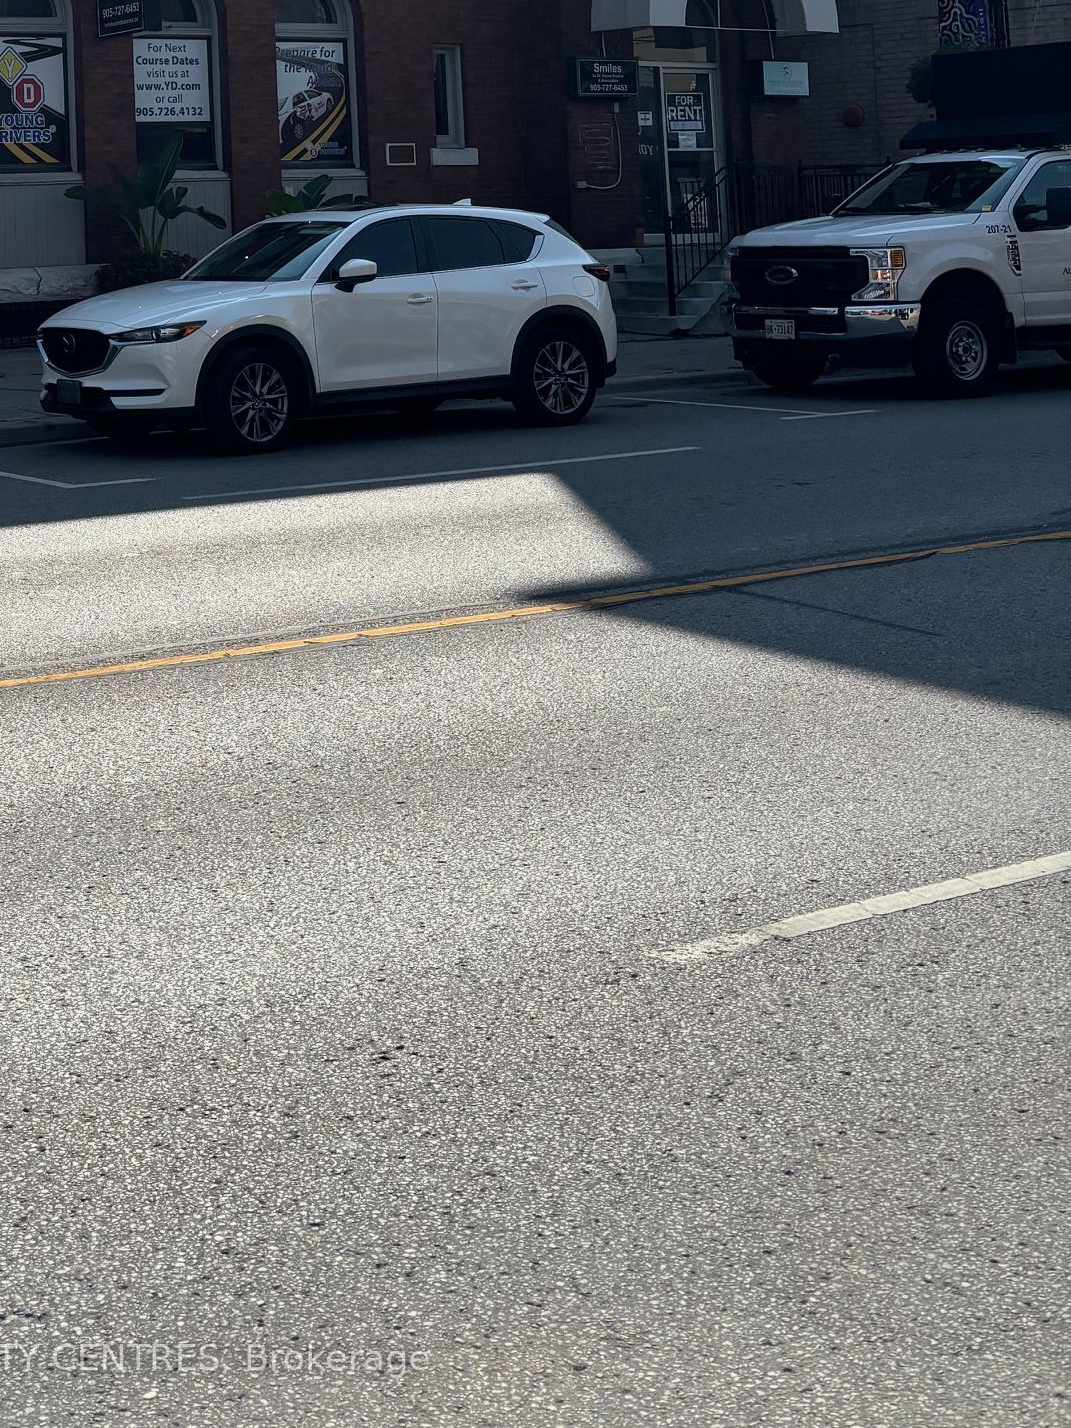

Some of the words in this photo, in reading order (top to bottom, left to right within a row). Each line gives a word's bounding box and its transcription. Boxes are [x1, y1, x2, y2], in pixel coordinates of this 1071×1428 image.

[147, 43, 162, 53] For
[165, 43, 187, 53] Next
[275, 46, 317, 59] Prepare
[319, 46, 336, 58] for
[135, 56, 170, 65] Course
[171, 56, 200, 65] Dates
[284, 62, 302, 73] the
[593, 63, 622, 73] Smiles
[146, 68, 166, 78] visit
[168, 70, 179, 78] us
[180, 69, 190, 78] at
[136, 81, 201, 91] www.YD.com
[23, 83, 35, 104] D
[155, 96, 166, 104] or
[167, 93, 183, 104] call
[675, 95, 694, 106] FOR
[136, 107, 204, 117] 905.726.4132
[668, 106, 702, 121] RENT
